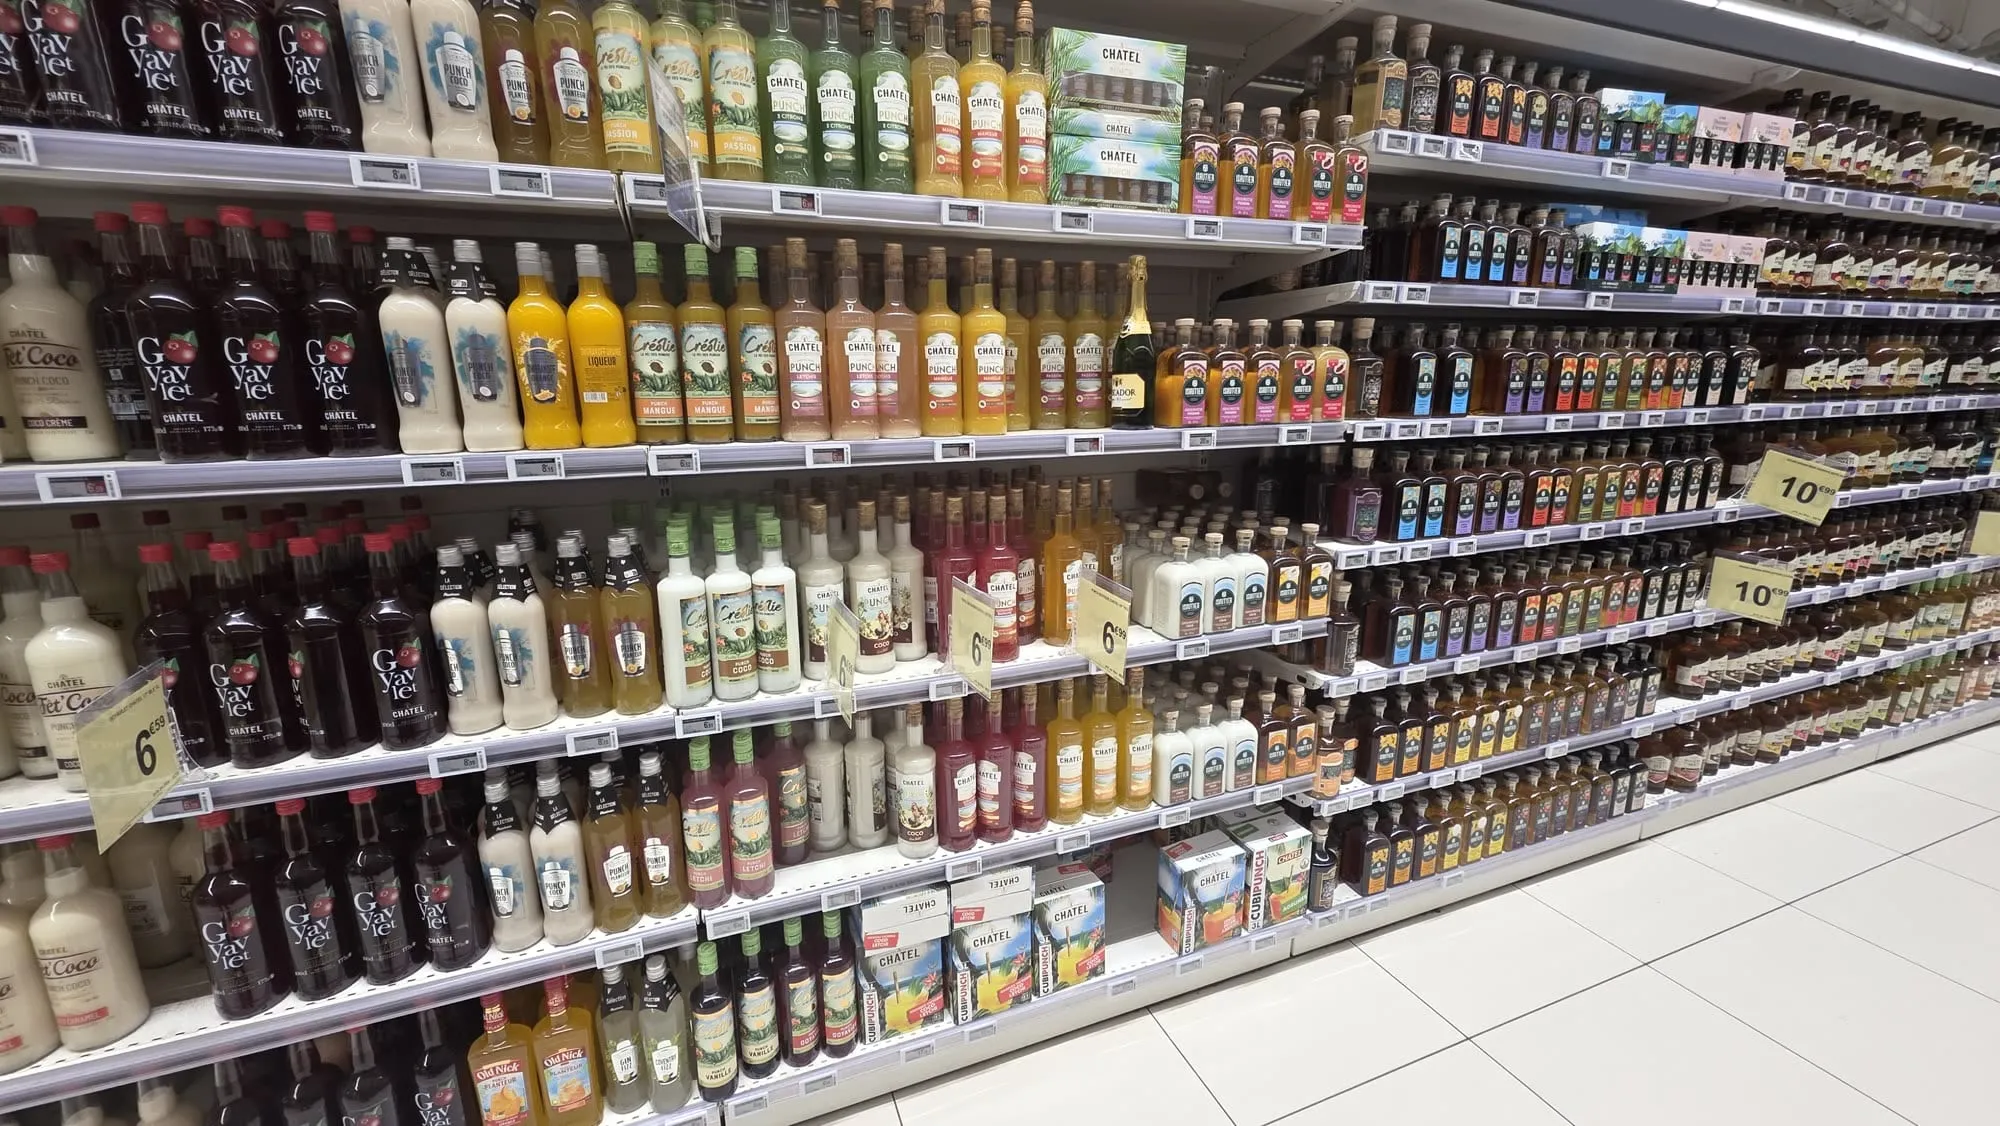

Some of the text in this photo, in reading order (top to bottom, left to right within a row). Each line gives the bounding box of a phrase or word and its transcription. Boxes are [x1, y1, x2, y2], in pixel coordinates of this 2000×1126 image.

[1102, 48, 1141, 64] CHATEL
[40, 54, 75, 77] let
[444, 63, 472, 79] PUNCH
[145, 71, 179, 91] let
[222, 75, 255, 96] let
[296, 78, 324, 96] let
[449, 76, 470, 87] COCO
[560, 77, 586, 91] PUNCH
[770, 77, 806, 92] CHATEL
[46, 91, 87, 104] CHATEL
[820, 89, 853, 101] CHATEL
[878, 90, 908, 103] CHATEL
[146, 103, 190, 118] CHATEL
[773, 99, 805, 113] PUNCH
[971, 98, 1001, 110] CHATEL
[223, 109, 263, 122] CHATEL
[297, 108, 332, 121] CHATEL
[823, 109, 854, 123] PUNCH
[879, 109, 909, 123] PUNCH
[1019, 106, 1045, 119] CHATEL
[1106, 124, 1133, 135] CHATEL
[723, 141, 757, 153] PASSION
[1100, 150, 1138, 164] CHATEL
[10, 331, 49, 340] CHATEL
[788, 343, 821, 353] CHATEL
[927, 347, 956, 356] CHATEL
[977, 347, 1004, 357] CHATEL
[1040, 347, 1065, 356] CHATEL
[1076, 347, 1102, 356] CHATEL
[587, 355, 617, 367] LIQUEUR
[790, 364, 820, 373] PUNCH
[929, 365, 956, 374] PUNCH
[161, 382, 195, 401] let
[246, 382, 276, 401] let
[322, 383, 351, 400] let
[245, 411, 284, 422] CHATEL
[324, 411, 358, 421] CHATEL
[642, 406, 676, 415] MANGUE
[694, 406, 727, 415] MANGUE
[162, 412, 204, 424] CHATEL
[1782, 476, 1837, 505] 10€99
[990, 583, 1017, 593] CHATEL
[1735, 581, 1790, 607] 10€99
[1102, 621, 1127, 654] 6€99
[873, 641, 890, 649] COCO
[972, 631, 992, 667] 6€99
[732, 664, 753, 675] COCO
[47, 677, 86, 690] CHATEL
[391, 684, 418, 700] let
[226, 700, 256, 717] let
[392, 705, 426, 719] CHATEL
[229, 725, 264, 737] CHATEL
[136, 715, 166, 776] 6€59
[647, 857, 666, 868] PUNCH
[1195, 852, 1223, 863] CHATEL
[1278, 849, 1302, 864] CHATEL
[608, 866, 631, 879] PUNCH
[742, 861, 766, 873] LETCHI
[545, 880, 567, 892] PUNCH
[989, 876, 1020, 889] CHATEL
[1200, 871, 1231, 887] CHATEL
[1251, 850, 1265, 921] CUBIPUNCH
[549, 889, 563, 897] COCO
[1039, 885, 1068, 898] CHATEL
[903, 900, 937, 913] CHATEL
[1054, 904, 1088, 922] CHATEL
[371, 918, 398, 938] let
[426, 914, 450, 930] let
[1184, 909, 1194, 954] CUBIPUNCH
[305, 930, 333, 951] let
[428, 936, 455, 945] CHATEL
[972, 931, 1012, 948] CHATEL
[222, 950, 252, 971] let
[879, 950, 921, 968] CHATEL
[1041, 946, 1050, 994] CUBIPUNCH
[960, 972, 969, 1022] CUBIPUNCH
[866, 992, 877, 1043] CUBIPUNCH
[544, 1050, 583, 1068] Old Nick
[748, 1046, 775, 1058] VANILLE
[620, 1056, 632, 1067] GIN
[476, 1063, 520, 1081] Old Nick
[549, 1063, 583, 1077] PLANTEUR
[706, 1067, 732, 1081] VANILLE
[483, 1077, 517, 1091] PLANTEUR
[429, 1114, 453, 1126] let
